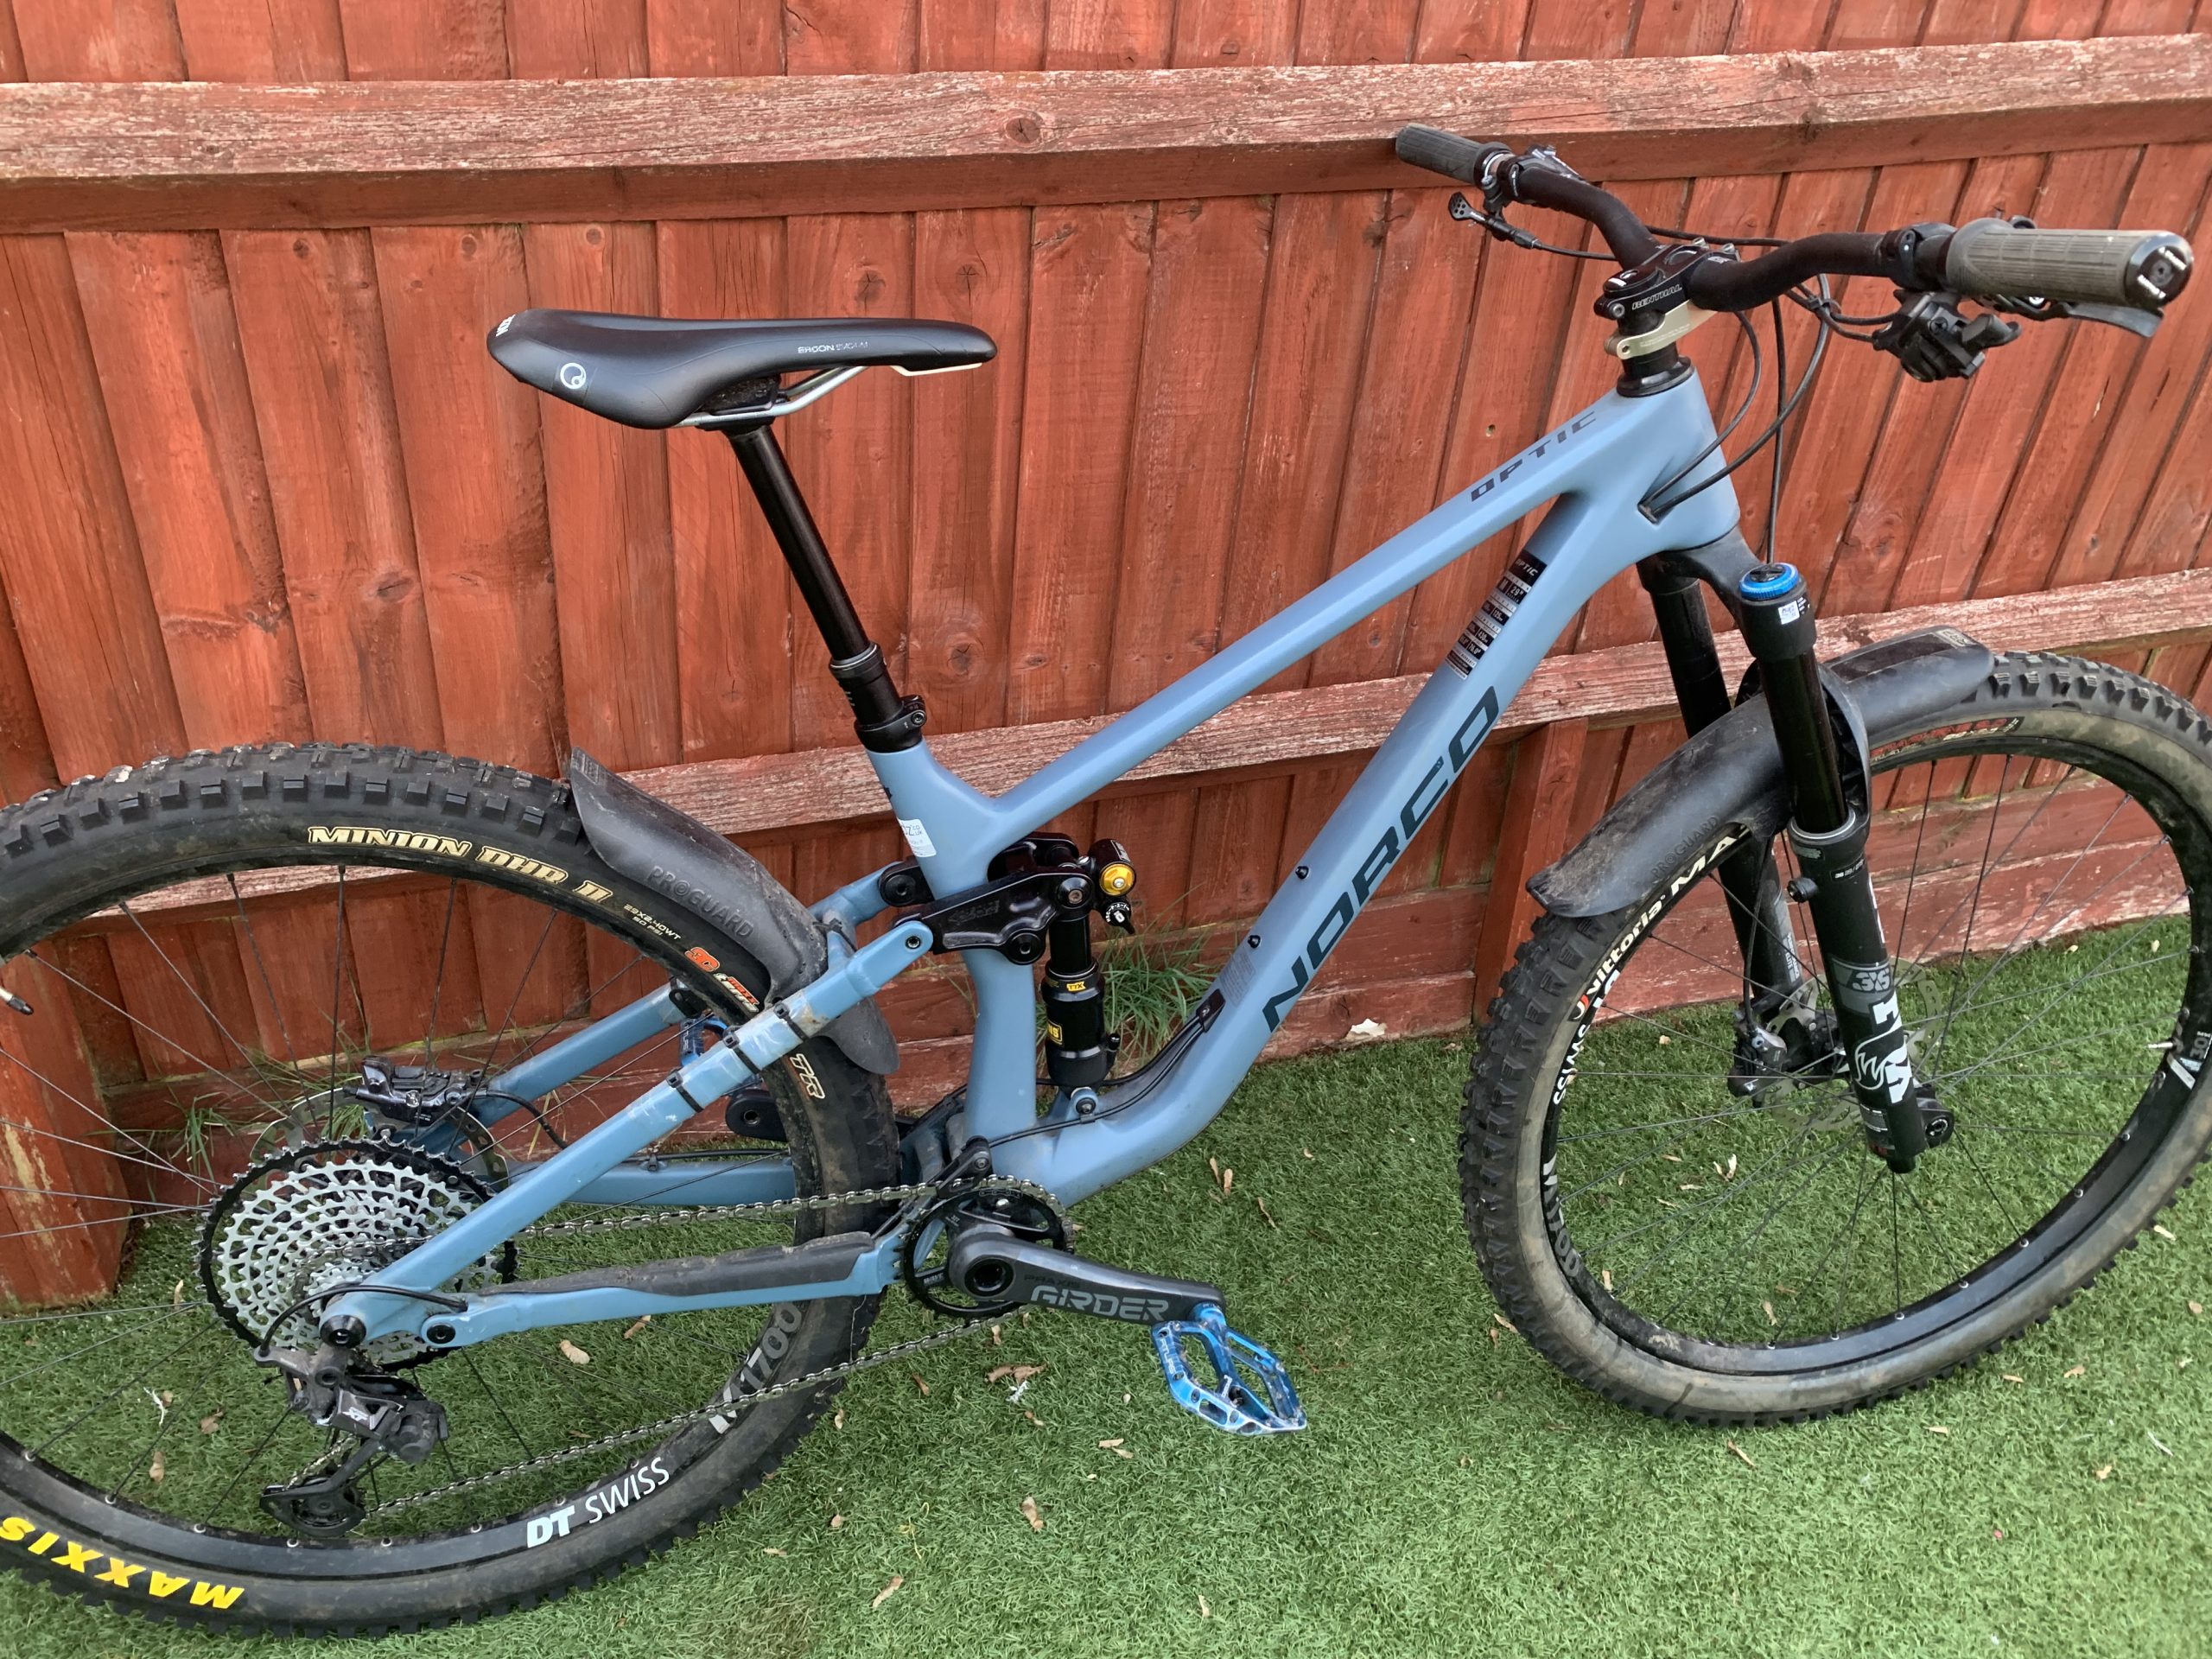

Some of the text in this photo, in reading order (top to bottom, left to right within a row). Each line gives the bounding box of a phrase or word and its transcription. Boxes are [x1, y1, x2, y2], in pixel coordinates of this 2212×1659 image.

[1631, 283, 1683, 310] RENTHAL
[798, 345, 835, 353] ERGON
[1471, 411, 1597, 502] OPTIC
[1514, 558, 1538, 577] OPTIC
[308, 826, 473, 858] MINION
[474, 845, 569, 885] DHR
[1262, 686, 1499, 1033] NORCO
[1651, 816, 1719, 880] PROGUARD
[648, 865, 754, 939] PROGUARD
[623, 903, 681, 941] 29X2.40WT
[647, 925, 664, 936] PSI
[684, 946, 721, 972] 3C
[1068, 982, 1085, 992] TTX
[1852, 967, 1892, 992] 36
[790, 1052, 825, 1099] TR
[1030, 1285, 1168, 1321] GIRDER
[526, 1456, 670, 1548] DT SWISS
[0, 1516, 245, 1609] MAXXIS
